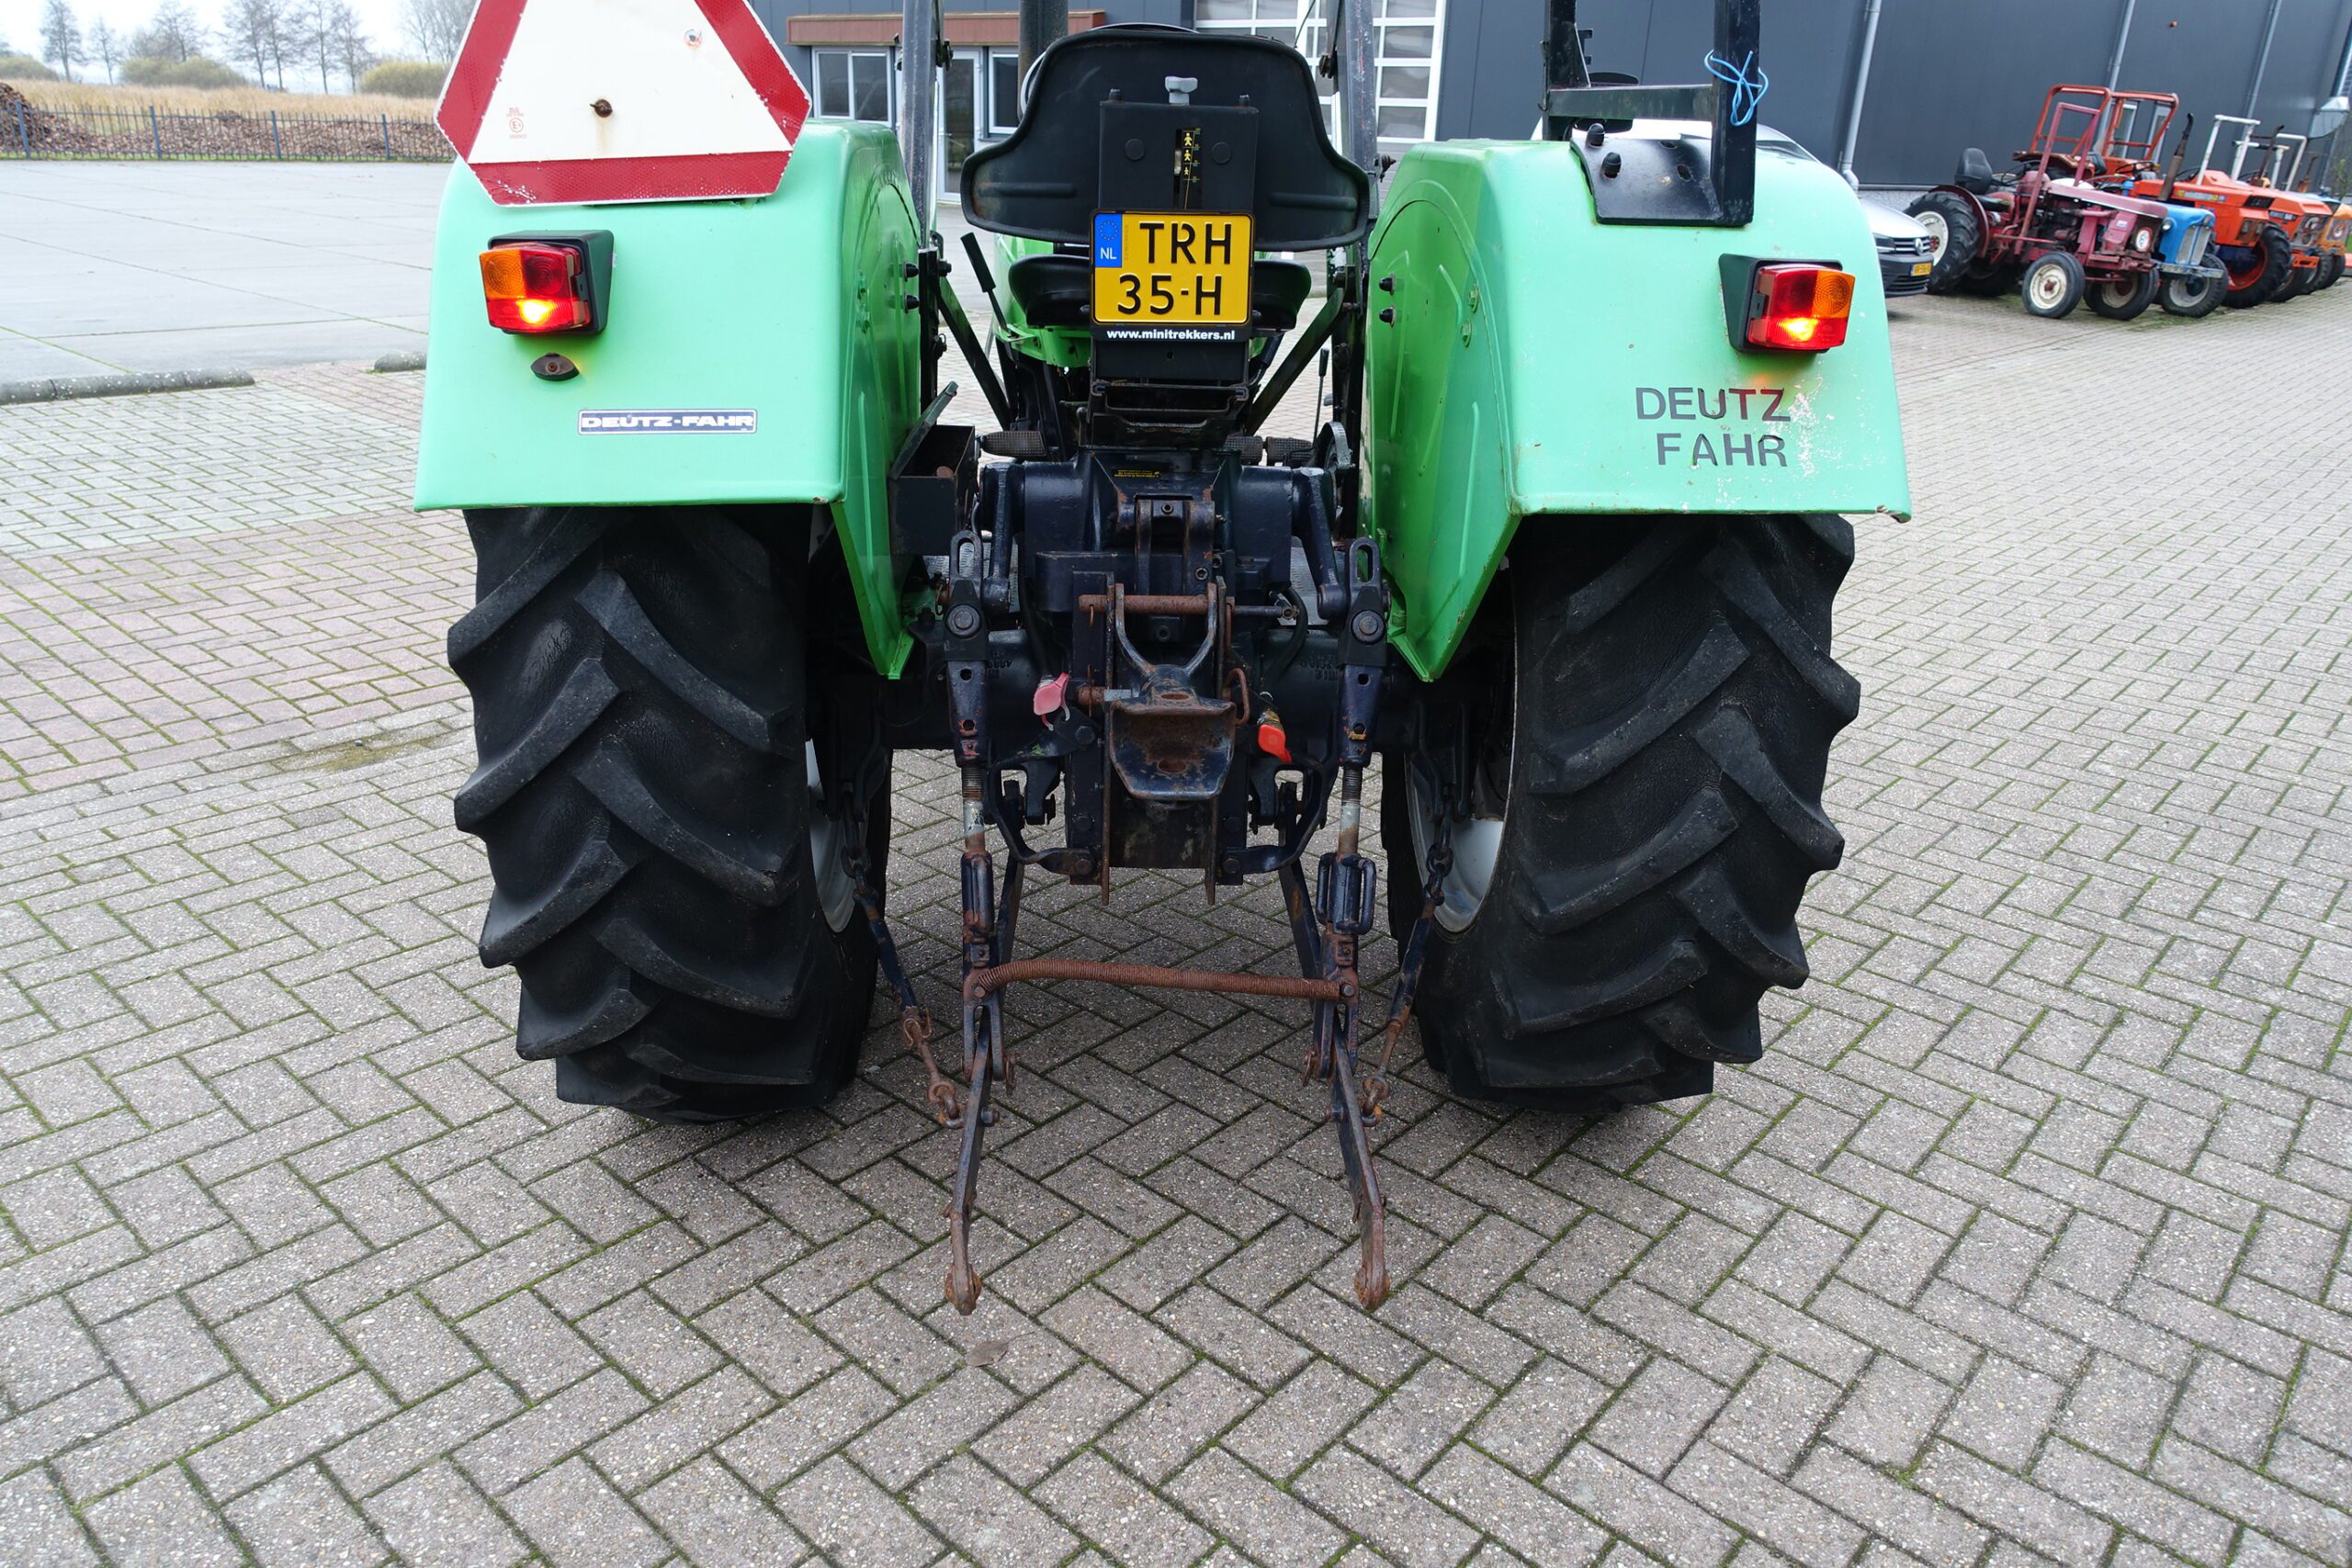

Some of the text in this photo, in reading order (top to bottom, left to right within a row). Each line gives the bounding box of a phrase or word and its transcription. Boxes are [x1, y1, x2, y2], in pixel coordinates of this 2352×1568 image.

[1100, 247, 1117, 260] NL
[1139, 221, 1232, 265] TRH
[1117, 274, 1222, 316] 35-H
[1106, 329, 1236, 341] www.minitrekkers.nl
[581, 415, 754, 428] DEUTZ-FAHR
[1635, 387, 1791, 422] DEUTZ
[1657, 433, 1788, 467] FAHR
